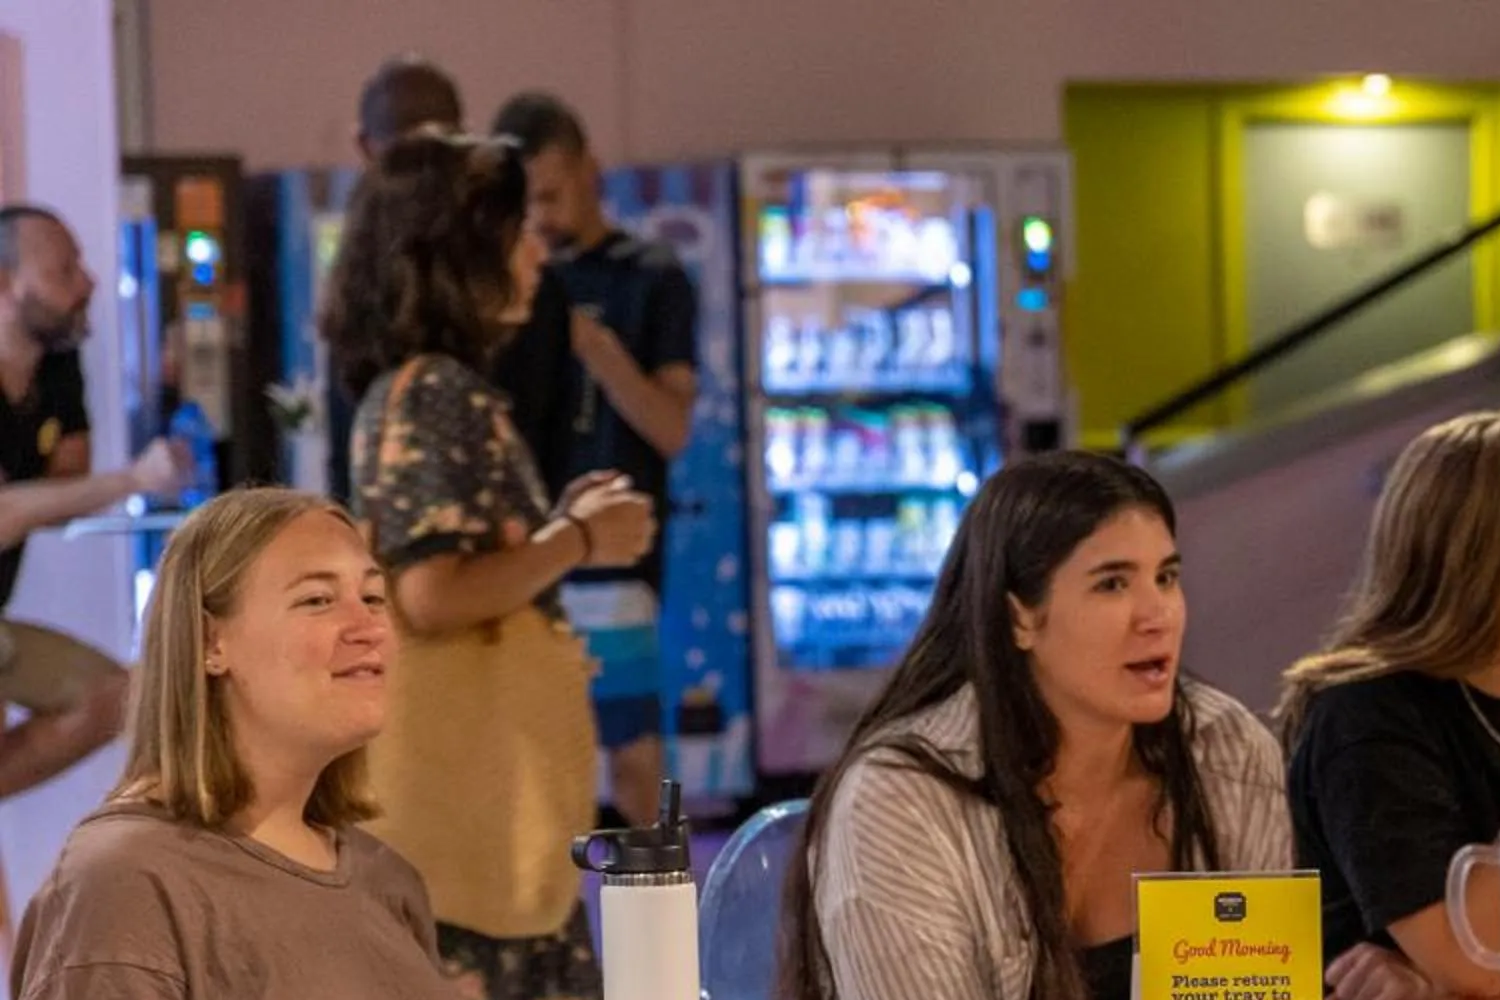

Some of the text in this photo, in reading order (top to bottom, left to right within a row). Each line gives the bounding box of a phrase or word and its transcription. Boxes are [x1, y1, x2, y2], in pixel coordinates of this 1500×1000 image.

[1173, 937, 1292, 965] Good Morning
[1171, 974, 1291, 988] Please return
